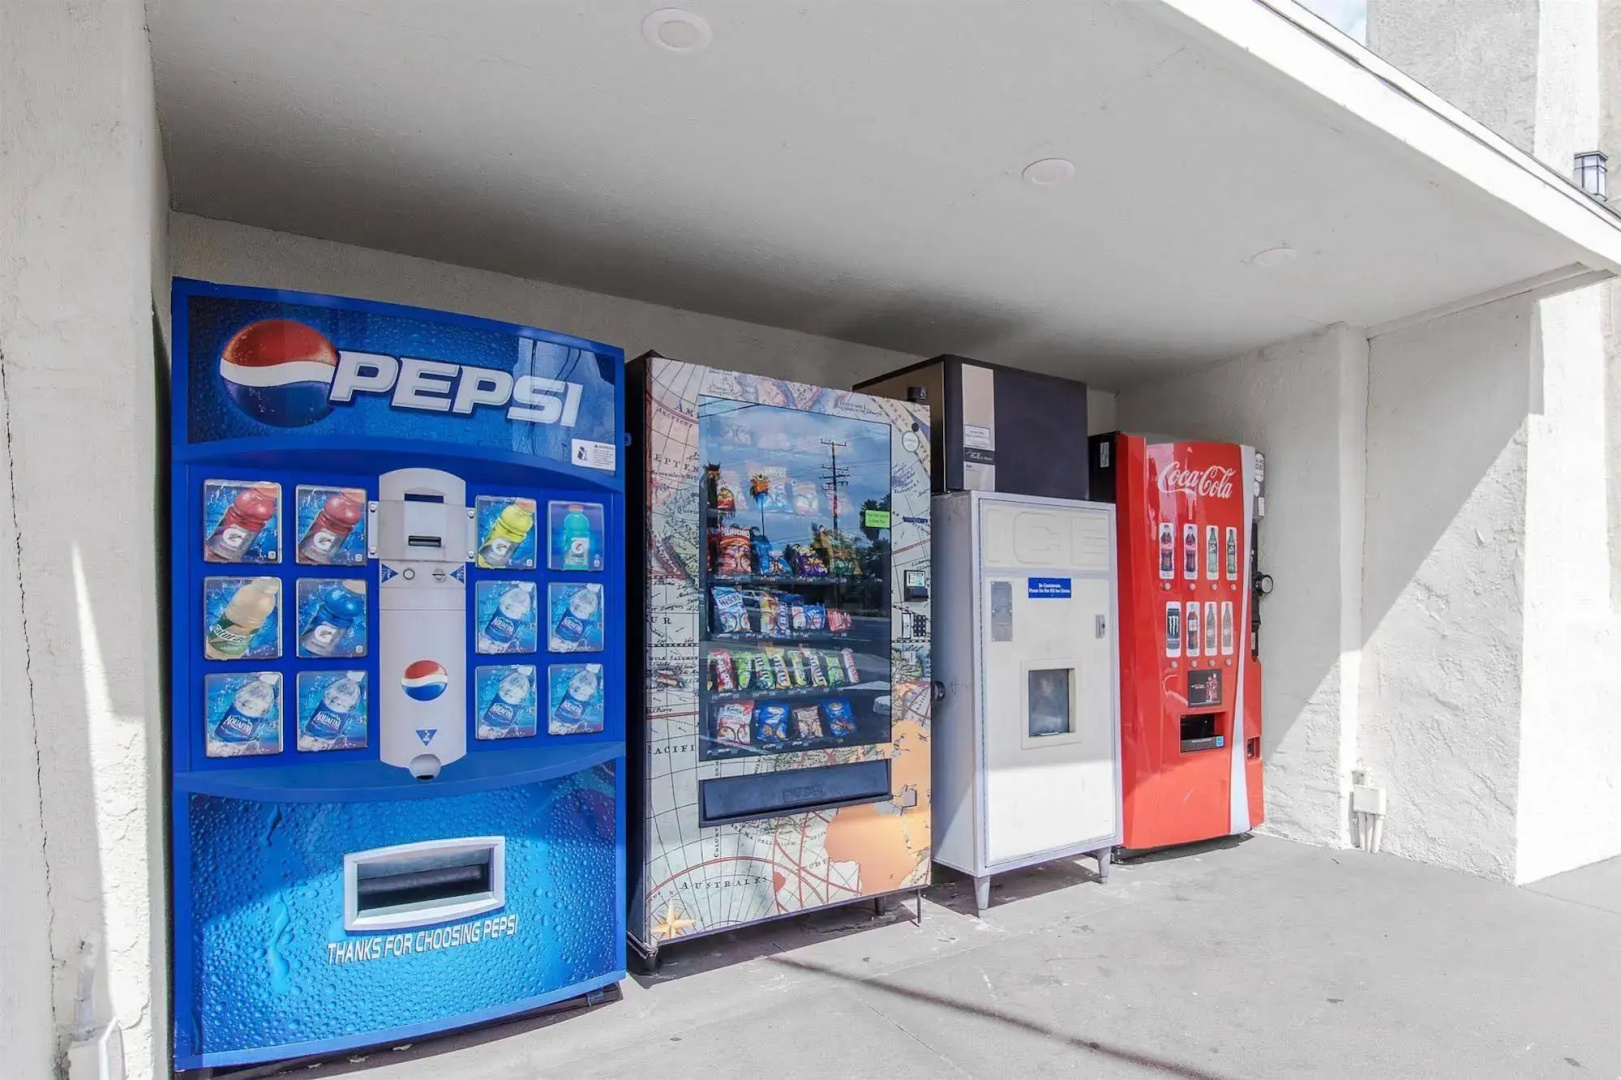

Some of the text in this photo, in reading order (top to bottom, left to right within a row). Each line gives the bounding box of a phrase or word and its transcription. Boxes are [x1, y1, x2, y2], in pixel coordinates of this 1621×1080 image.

[329, 350, 584, 427] PEPSI
[327, 914, 519, 965] THANKS FOR CHOOSING PEPSI
